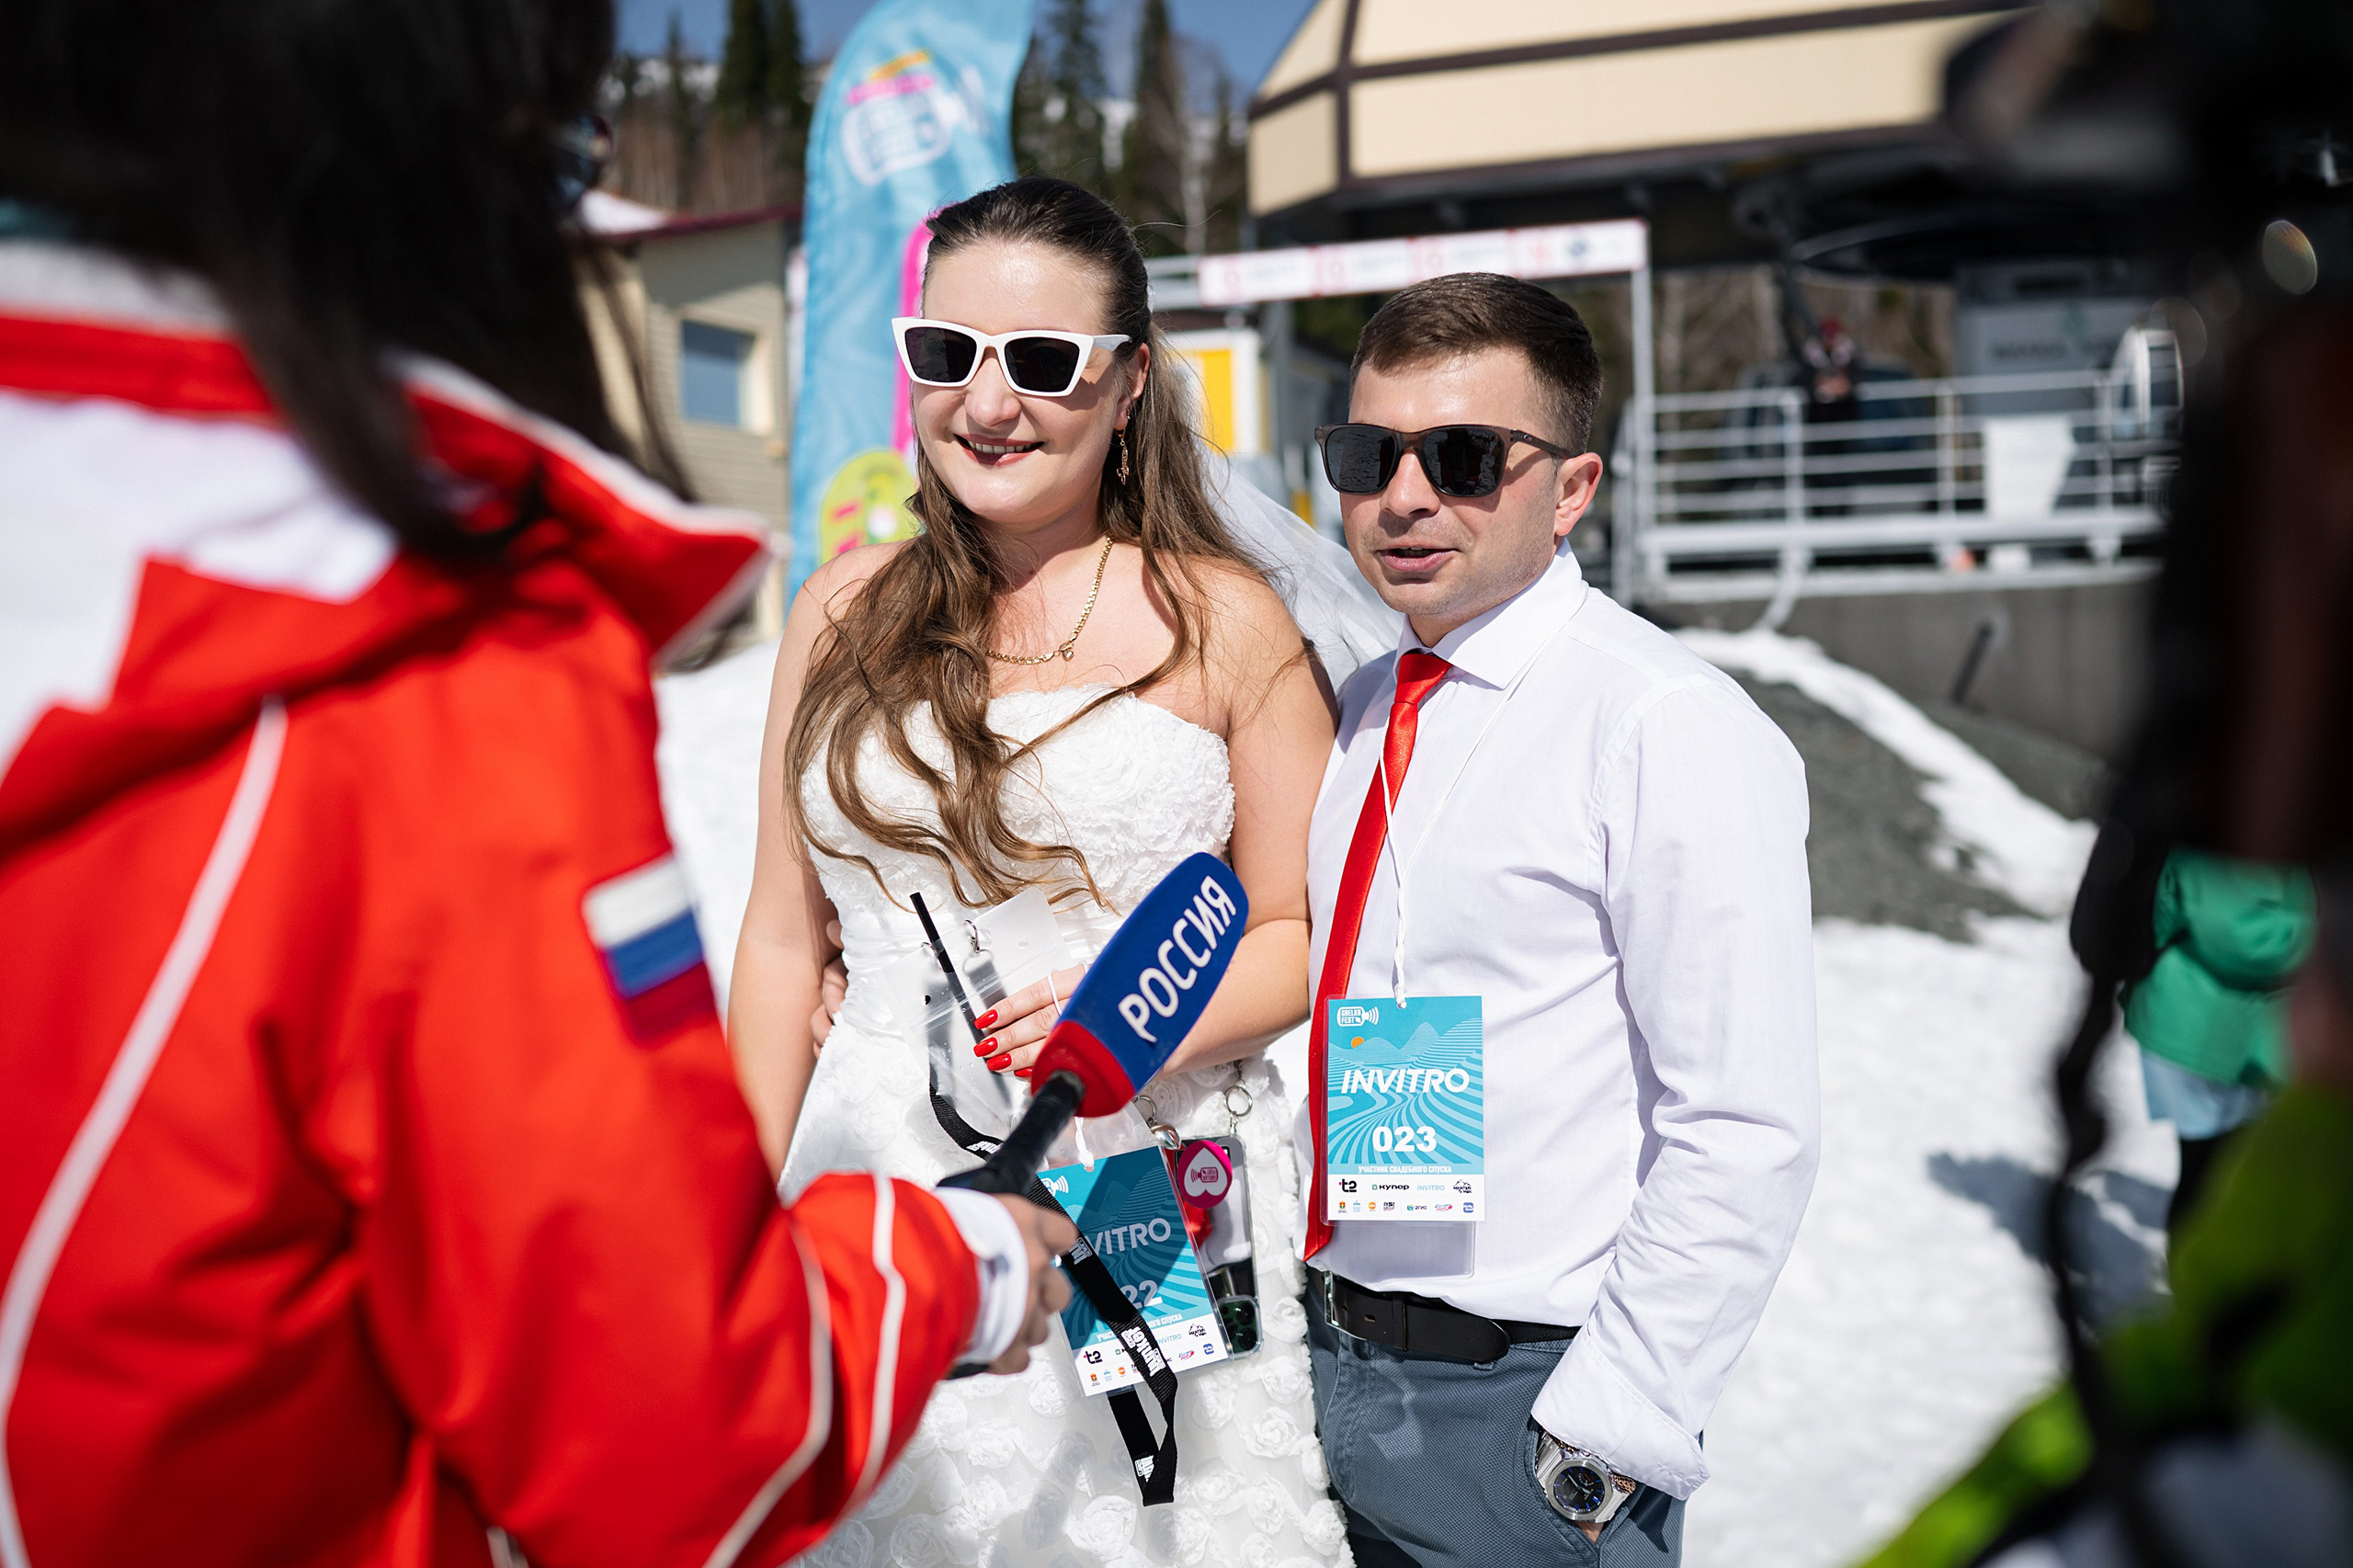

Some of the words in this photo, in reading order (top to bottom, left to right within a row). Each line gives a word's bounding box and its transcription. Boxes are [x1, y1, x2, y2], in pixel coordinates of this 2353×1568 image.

[1118, 875, 1236, 1043] РОССИЯ
[1341, 1068, 1470, 1094] INVITRO
[1372, 1126, 1438, 1153] 023
[1358, 1165, 1388, 1174] УЧАСТНИК
[1389, 1165, 1427, 1174] СВАДЕБНОГО
[1428, 1165, 1452, 1174] СПУСКА
[1341, 1178, 1358, 1193] t2
[1085, 1218, 1171, 1256] VITRO
[1120, 1279, 1164, 1310] 22
